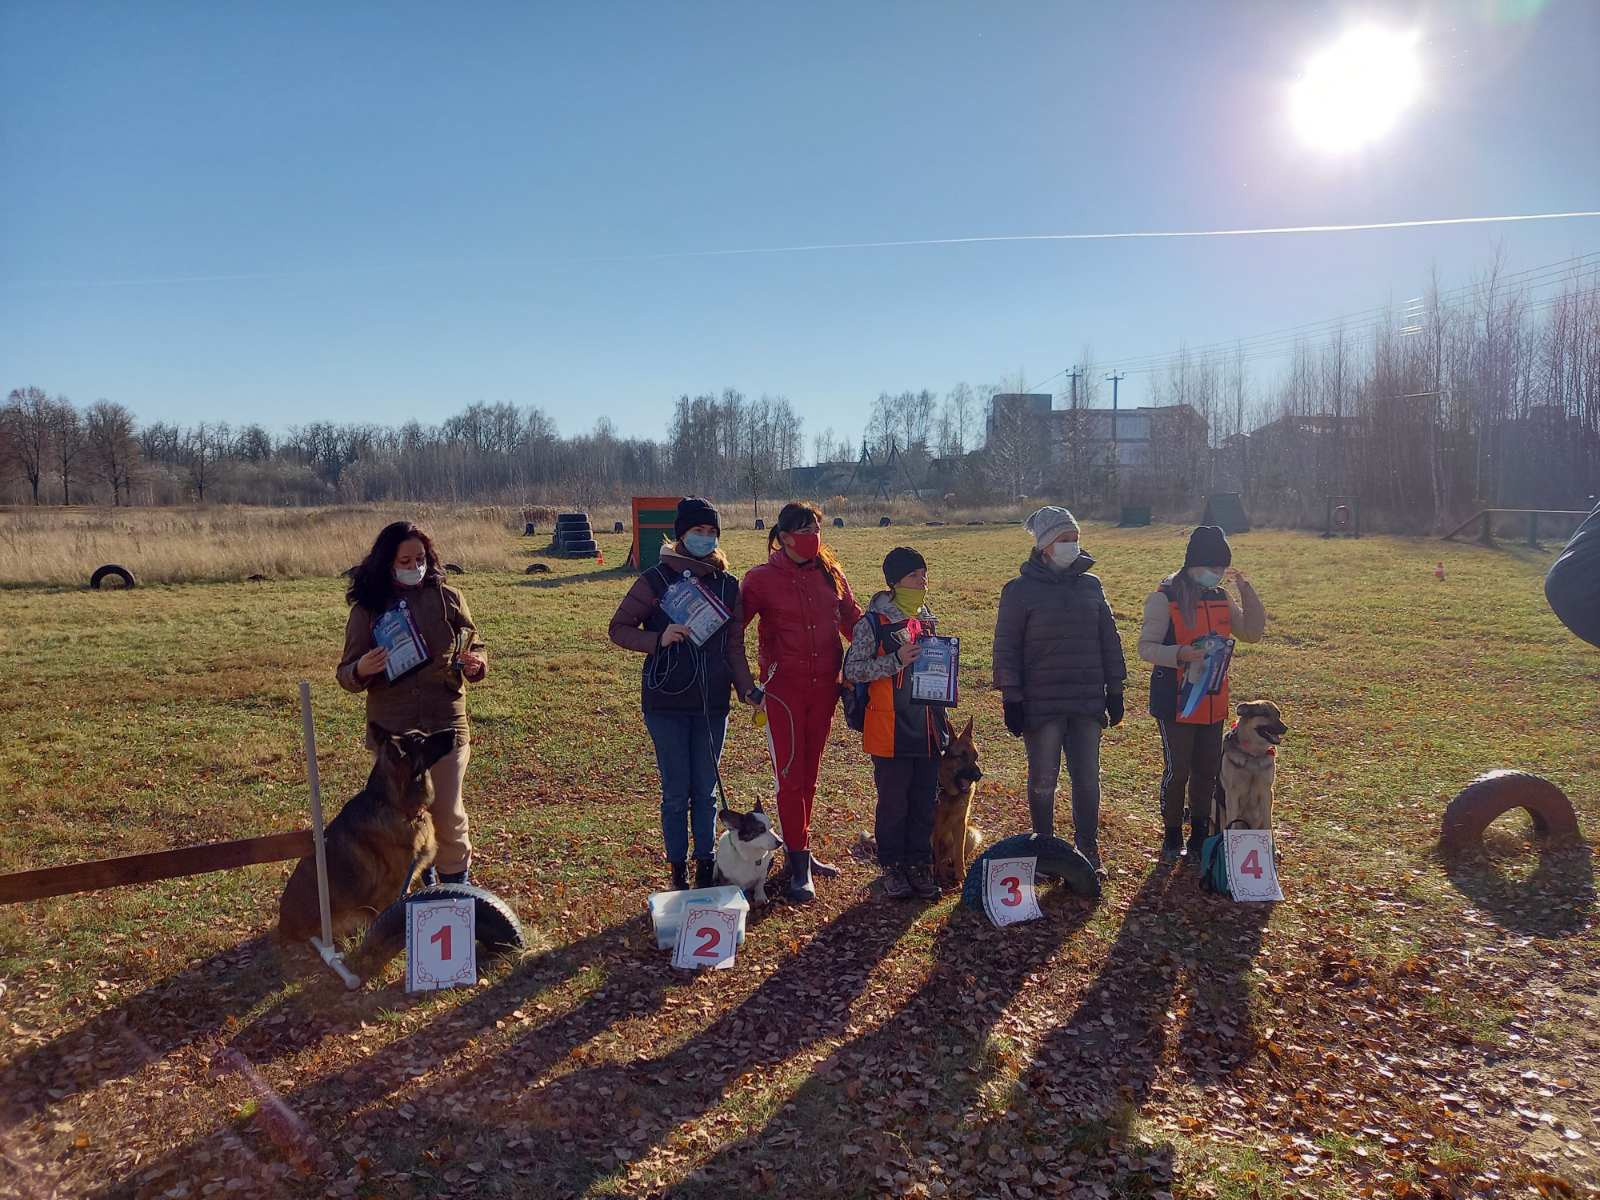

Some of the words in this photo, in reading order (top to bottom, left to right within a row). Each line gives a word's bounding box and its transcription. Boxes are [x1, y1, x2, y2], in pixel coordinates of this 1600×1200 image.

[1240, 850, 1263, 879] 4
[1000, 877, 1022, 906] 3
[431, 925, 452, 960] 1
[692, 927, 720, 957] 2
